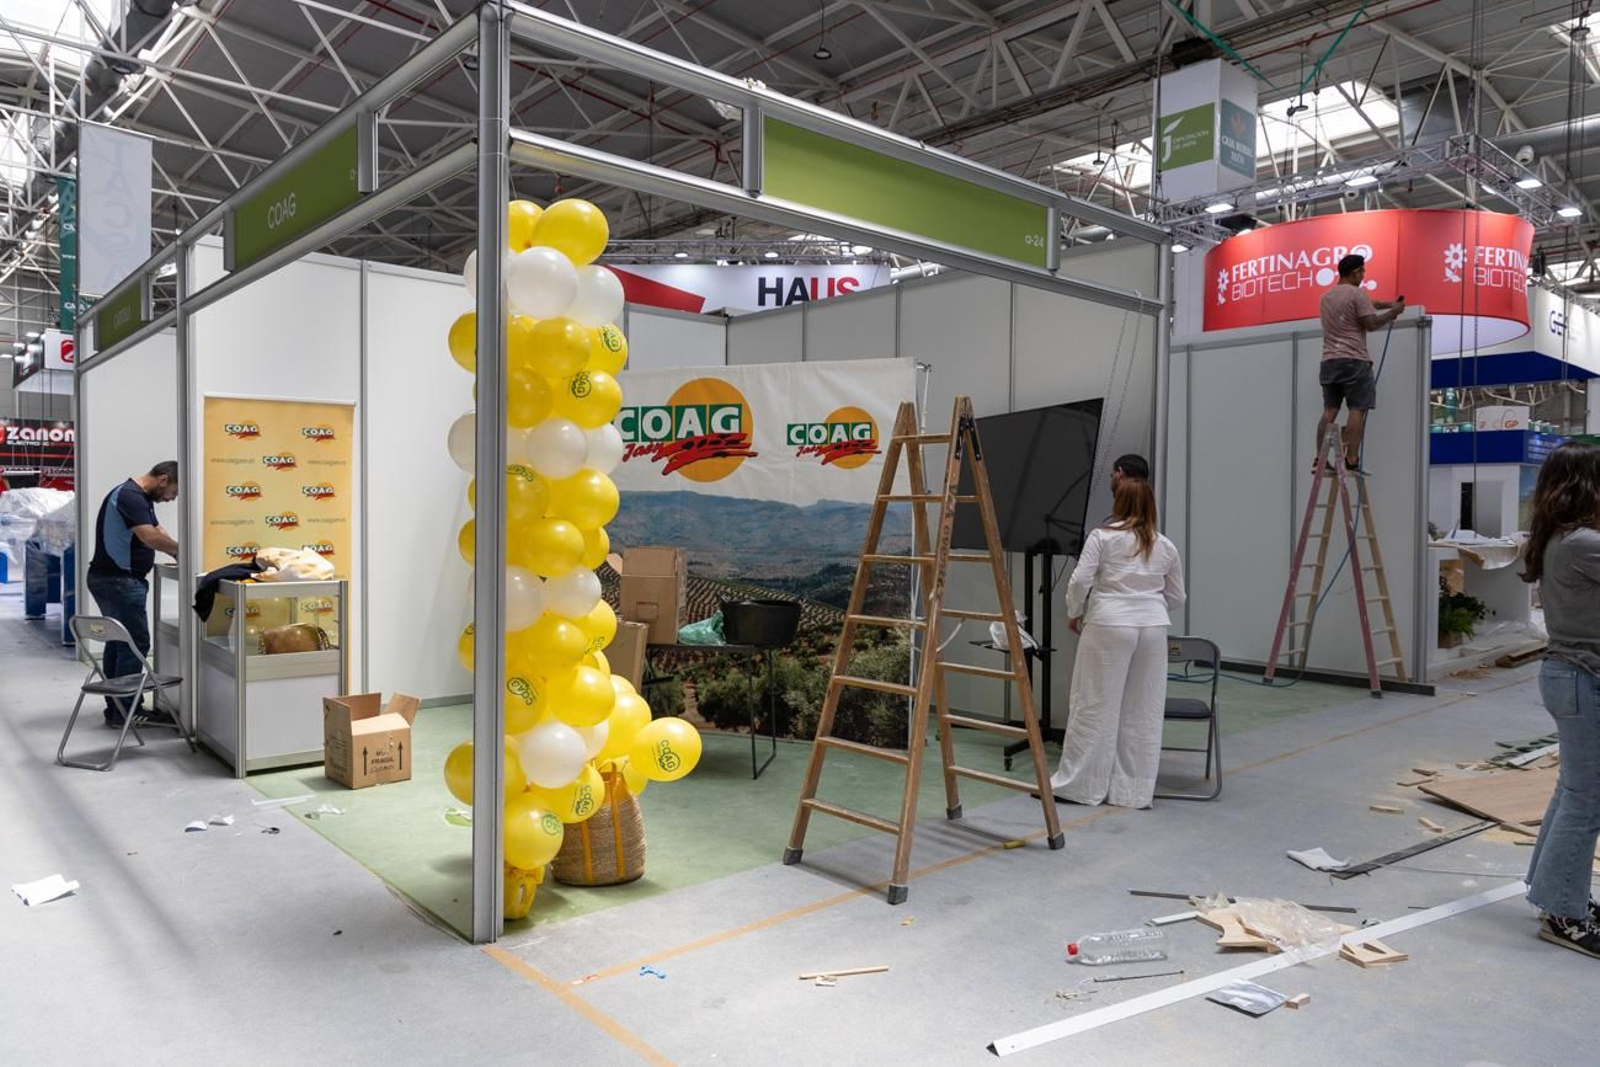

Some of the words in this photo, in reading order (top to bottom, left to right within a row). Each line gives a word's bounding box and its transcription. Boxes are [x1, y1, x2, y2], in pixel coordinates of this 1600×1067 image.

[268, 193, 296, 229] COAG
[1232, 270, 1313, 301] BIOTECH
[226, 424, 258, 433] COAG
[614, 407, 740, 439] COAG
[303, 428, 333, 436] COAG
[790, 424, 871, 443] COAG
[263, 456, 295, 464] COAG
[227, 485, 259, 494] COAG
[303, 486, 333, 494] COAG
[266, 515, 296, 524] COAG
[511, 679, 533, 706] COAG
[660, 739, 676, 769] COAG
